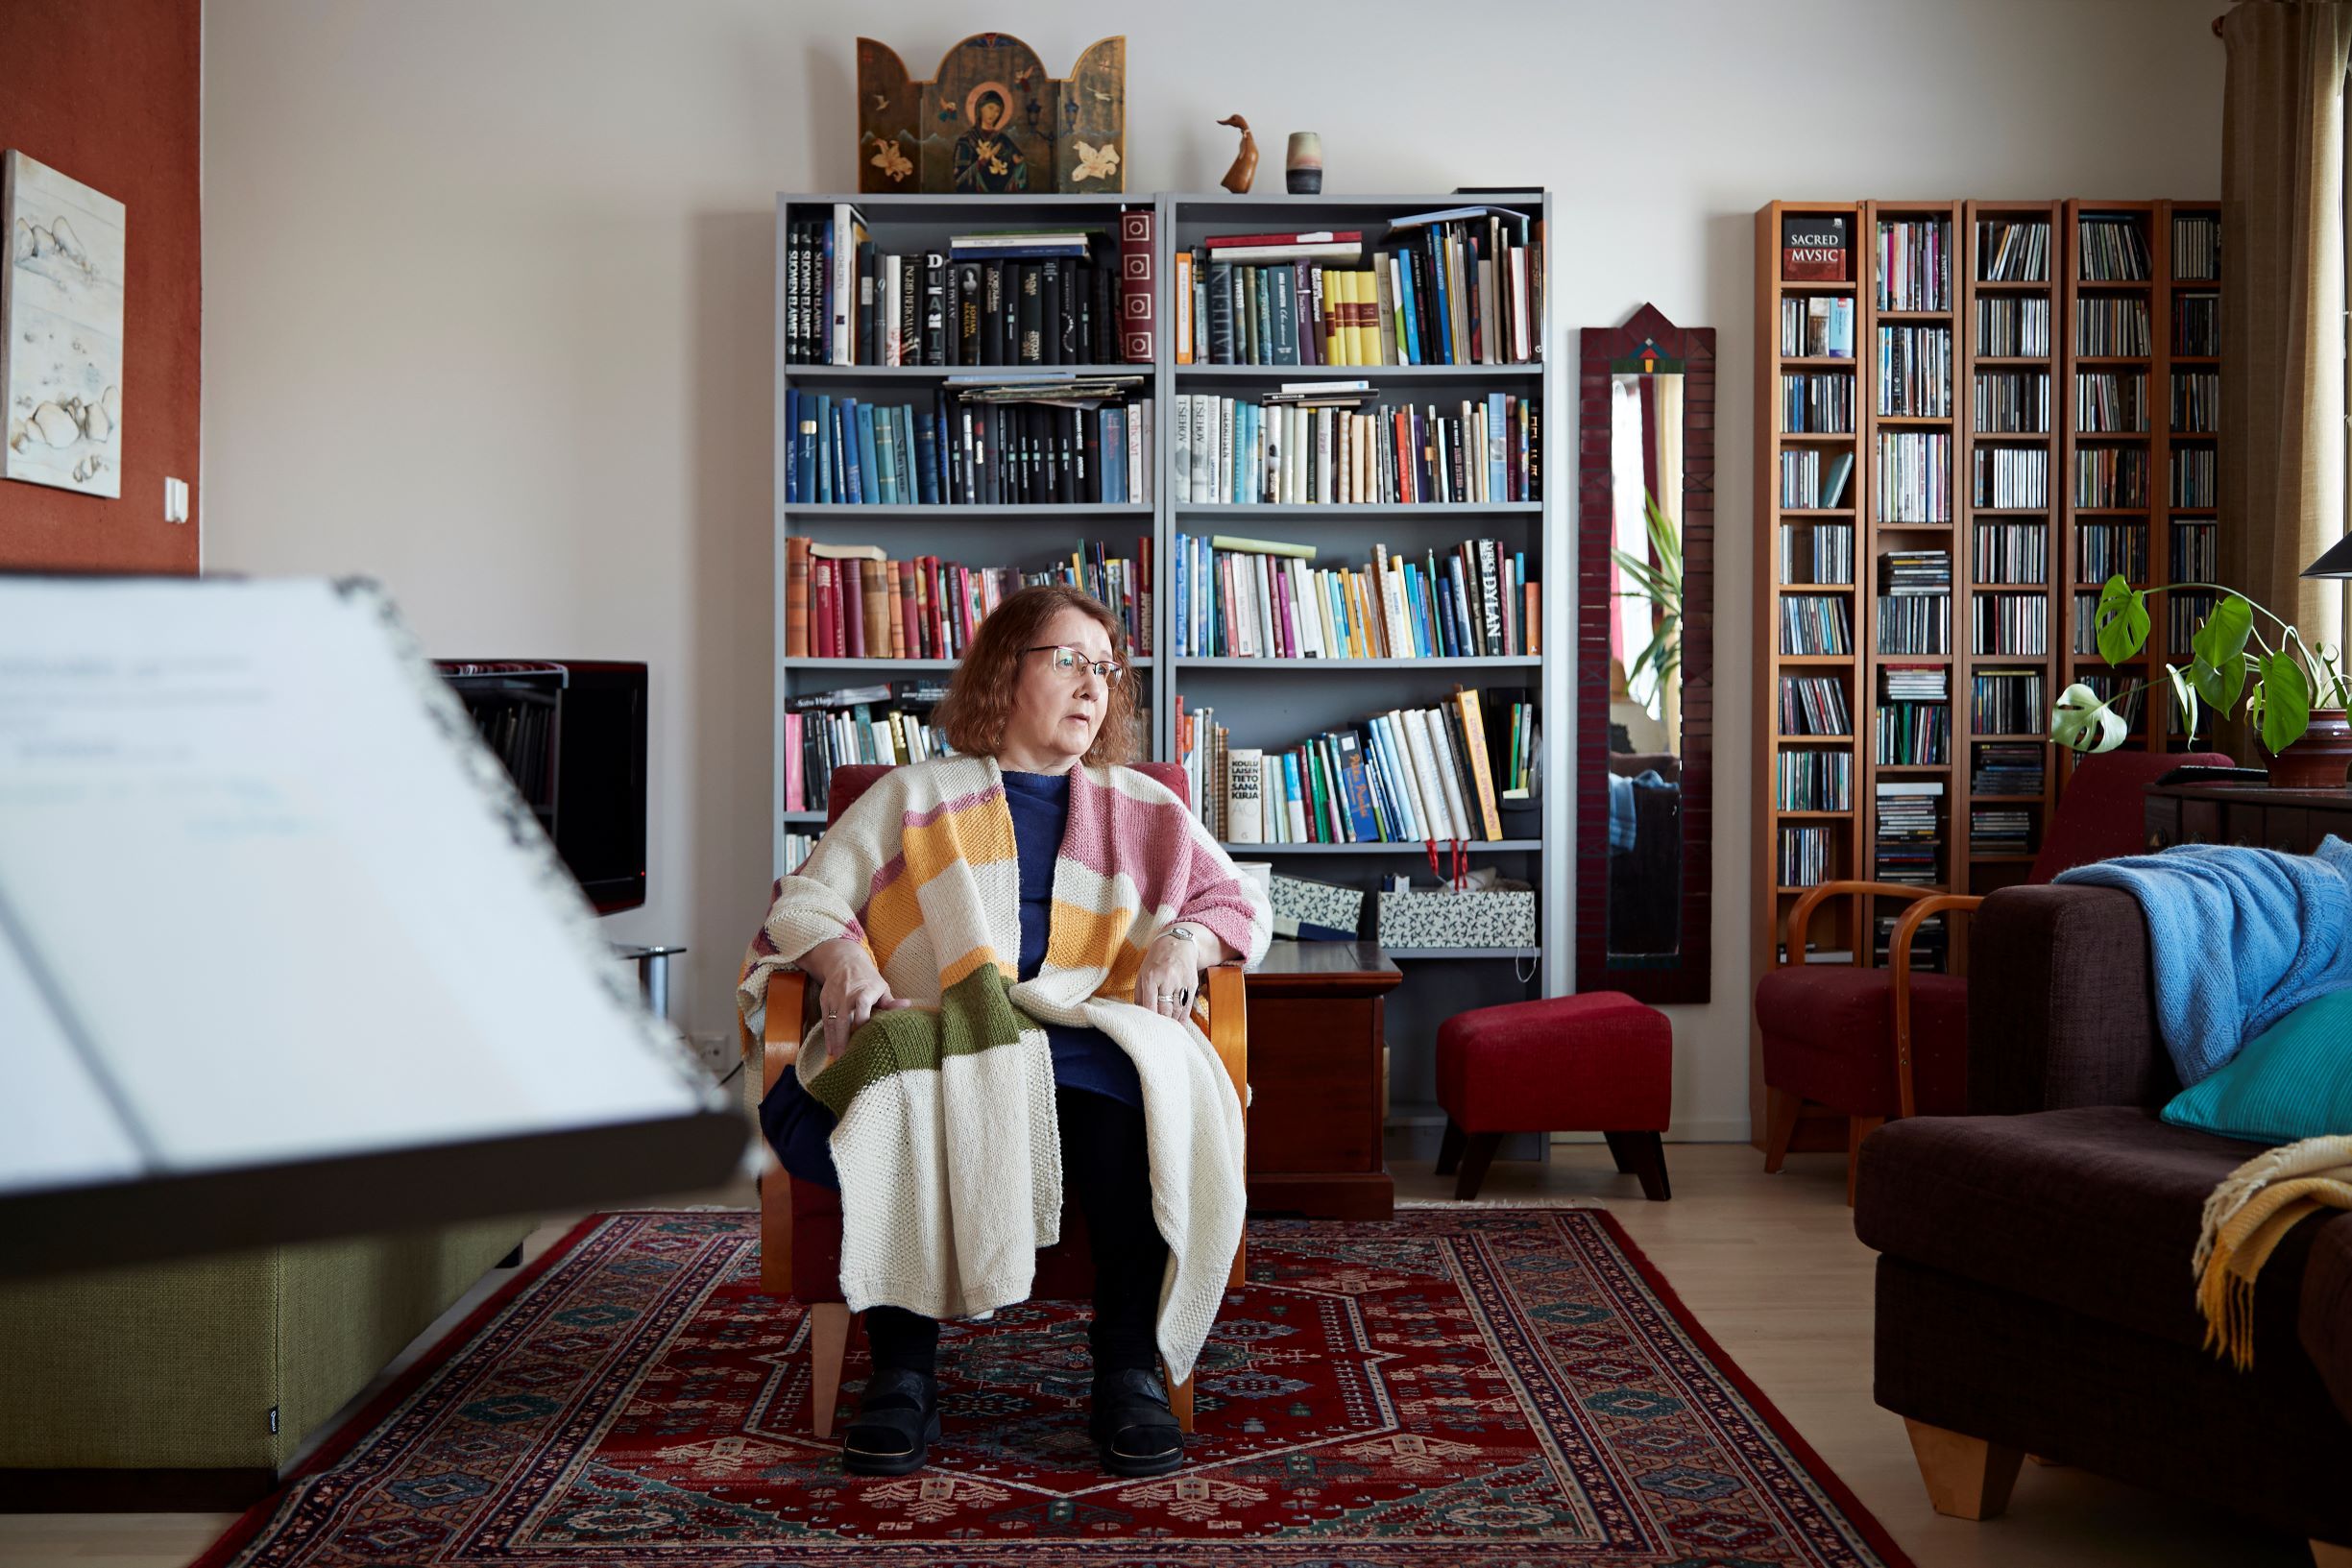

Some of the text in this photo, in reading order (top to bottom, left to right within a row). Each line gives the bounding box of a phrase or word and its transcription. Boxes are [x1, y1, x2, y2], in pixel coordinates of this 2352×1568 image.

[1791, 234, 1838, 245] SACRED
[1791, 249, 1838, 262] MVSIC
[788, 250, 799, 295] SUOMEN
[800, 250, 811, 295] SUOMEN
[904, 265, 914, 339] INGRID BERGMAN
[1129, 411, 1142, 456] Celtic Art
[1177, 399, 1188, 443] TŠEHOV
[1196, 399, 1207, 444] TŠEHOV
[1483, 541, 1501, 637] LYRICS DYLAN
